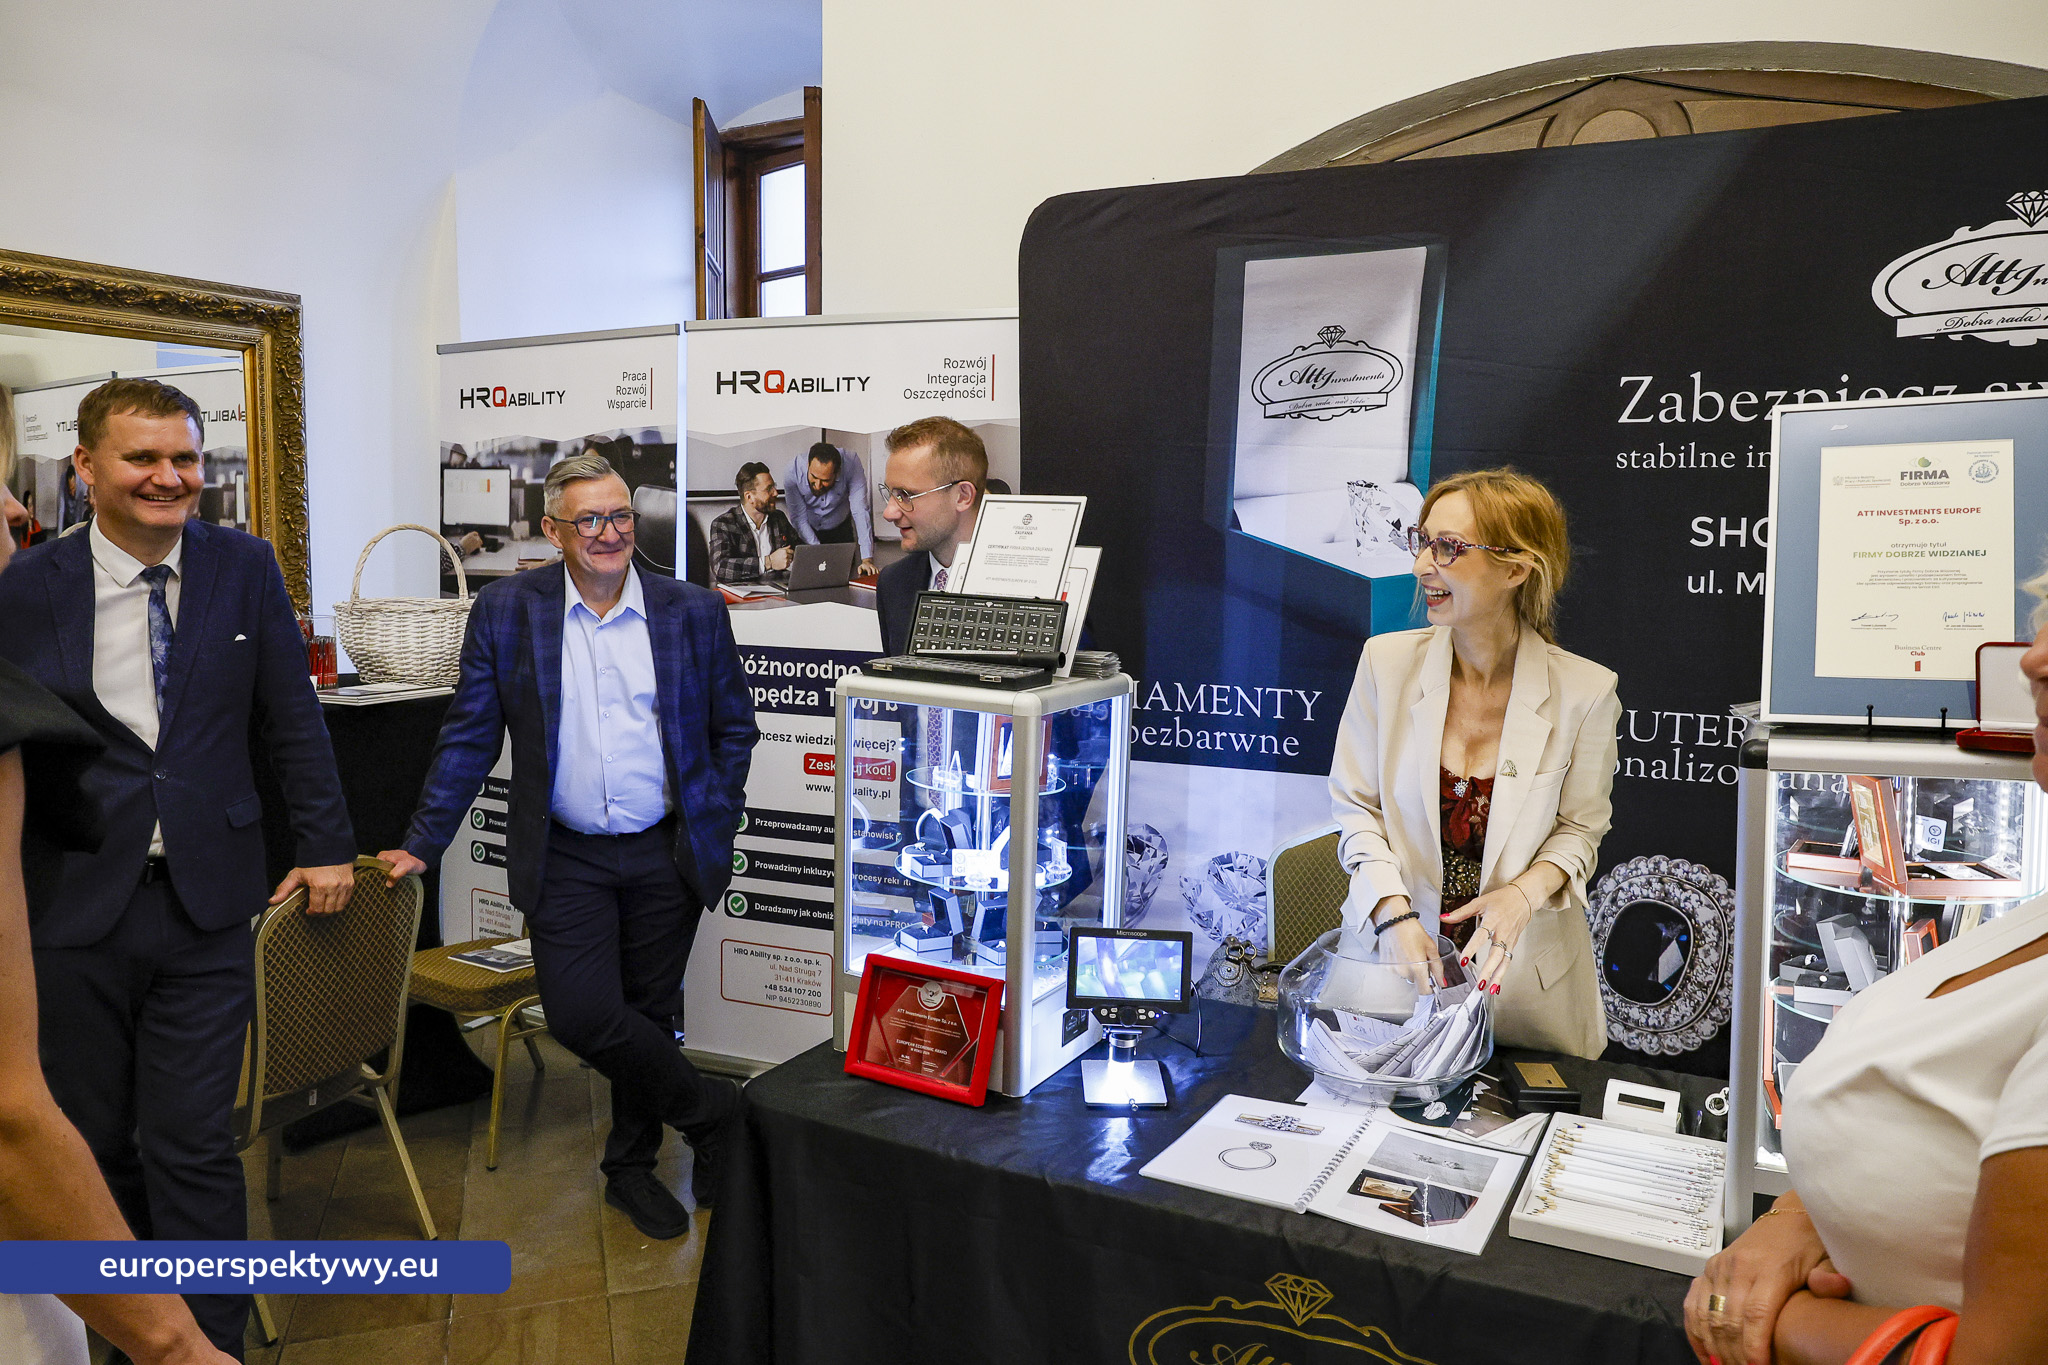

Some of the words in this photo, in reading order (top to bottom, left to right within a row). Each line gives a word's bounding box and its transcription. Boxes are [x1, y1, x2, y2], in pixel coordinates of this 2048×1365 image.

[944, 357, 986, 370] Rozwój
[622, 371, 647, 381] Praca
[927, 373, 986, 386] Integracja
[616, 384, 647, 397] Rozwój
[903, 388, 986, 401] Oszczędności
[607, 398, 647, 411] Wsparcie
[1616, 442, 1735, 468] stabilne
[1901, 470, 1949, 480] FIRMA
[1877, 508, 1942, 516] INVESTMENTS
[1687, 570, 1723, 594] ul.
[1132, 680, 1322, 721] IAMENTY
[865, 764, 891, 776] kod!
[755, 818, 822, 833] Przeprowadzamy
[1928, 837, 1940, 845] IGI
[755, 861, 802, 874] Prowadzimy
[755, 903, 797, 916] Doradzamy
[800, 908, 811, 917] jak
[750, 950, 771, 960] Ability
[797, 977, 821, 987] Kraków
